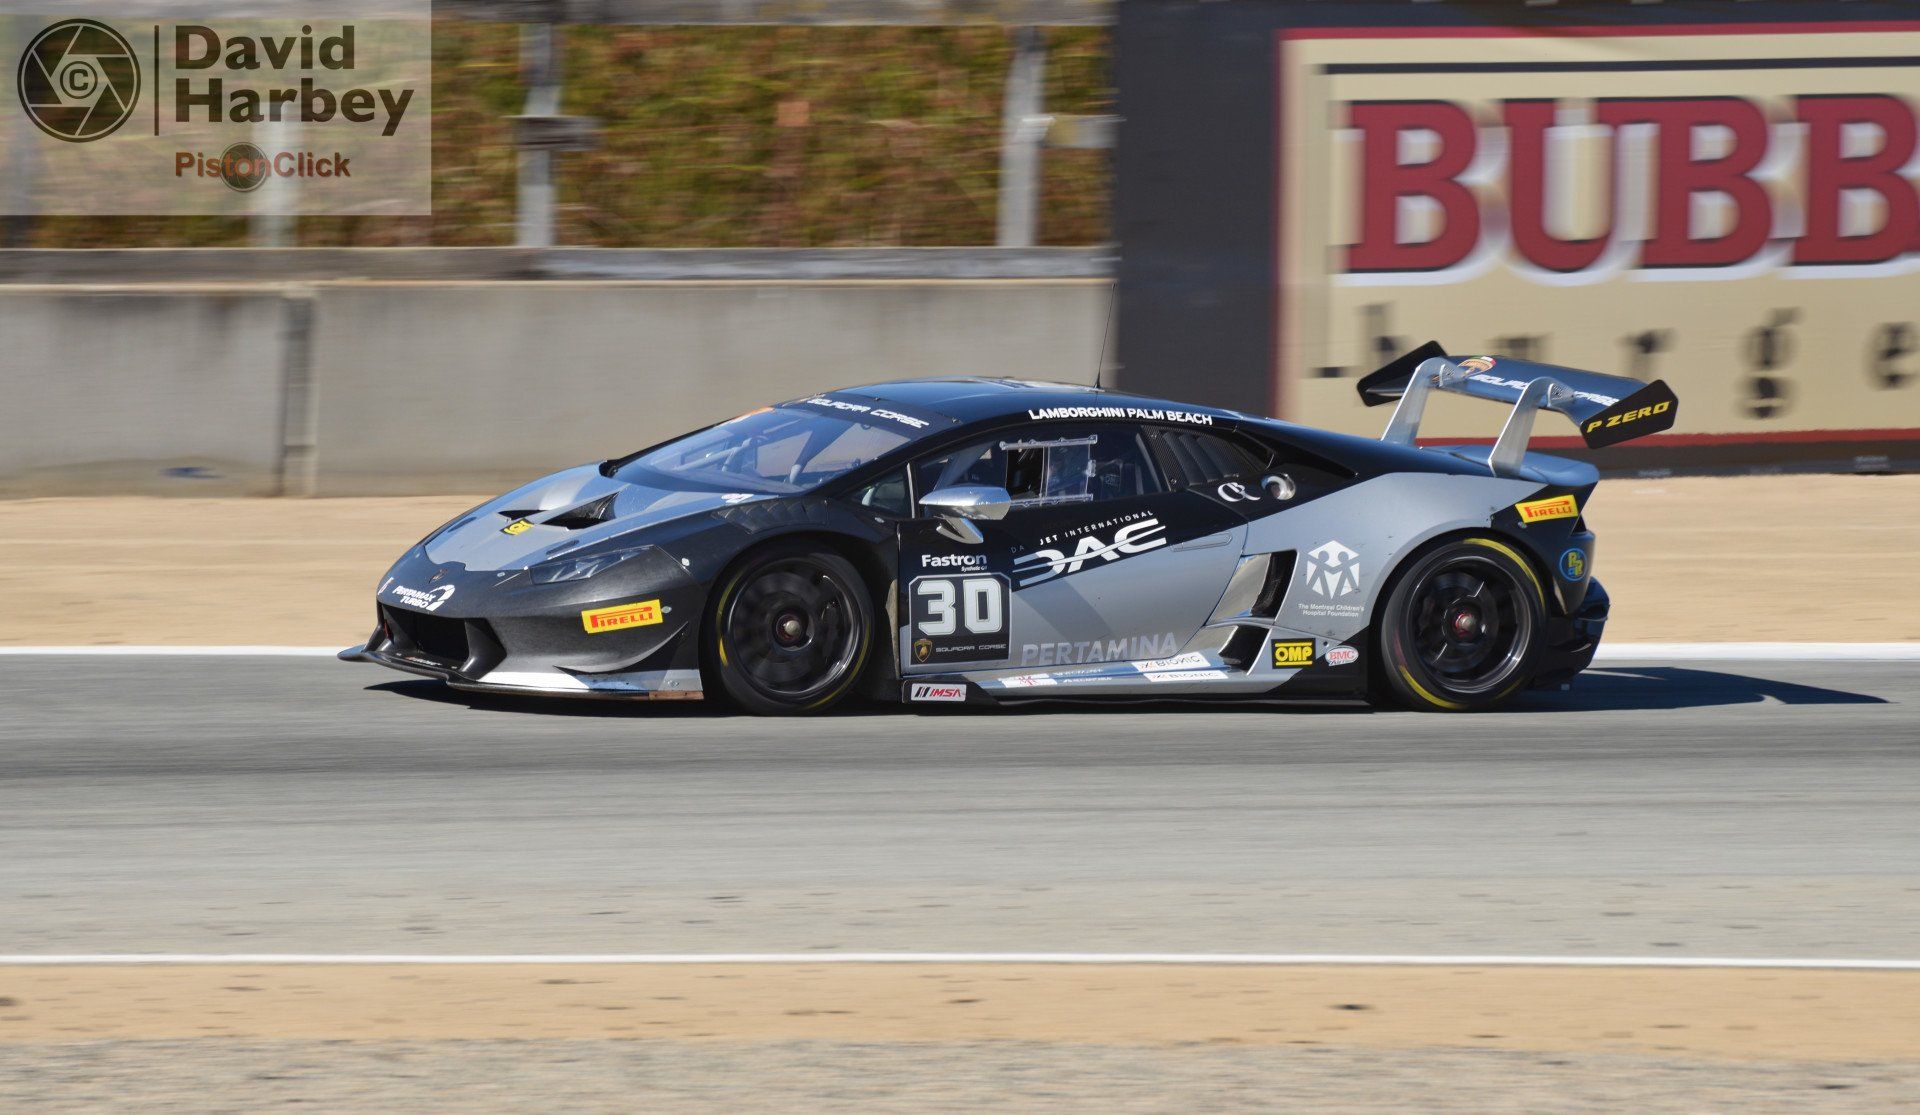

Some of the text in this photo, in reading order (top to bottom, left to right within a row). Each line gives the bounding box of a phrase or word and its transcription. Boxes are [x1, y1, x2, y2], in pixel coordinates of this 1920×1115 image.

[1345, 93, 1920, 273] BUBB
[869, 409, 930, 428] CORSE
[1028, 407, 1214, 425] LAMBORGHINI PALM BEACH
[1586, 401, 1672, 433] P ZERO
[1524, 500, 1573, 518] PIRELLI
[1039, 534, 1059, 546] JET
[1064, 510, 1154, 538] INTERNATIONAL
[921, 554, 988, 567] Fastron
[400, 595, 429, 608] TURBO
[917, 577, 1003, 636] 30
[589, 606, 654, 628] PIRELLI
[978, 643, 1007, 651] CORSE
[1020, 632, 1179, 667] PERTAMINA
[1274, 646, 1313, 662] OMP
[1329, 650, 1355, 660] BMC
[929, 688, 962, 697] IMSA
